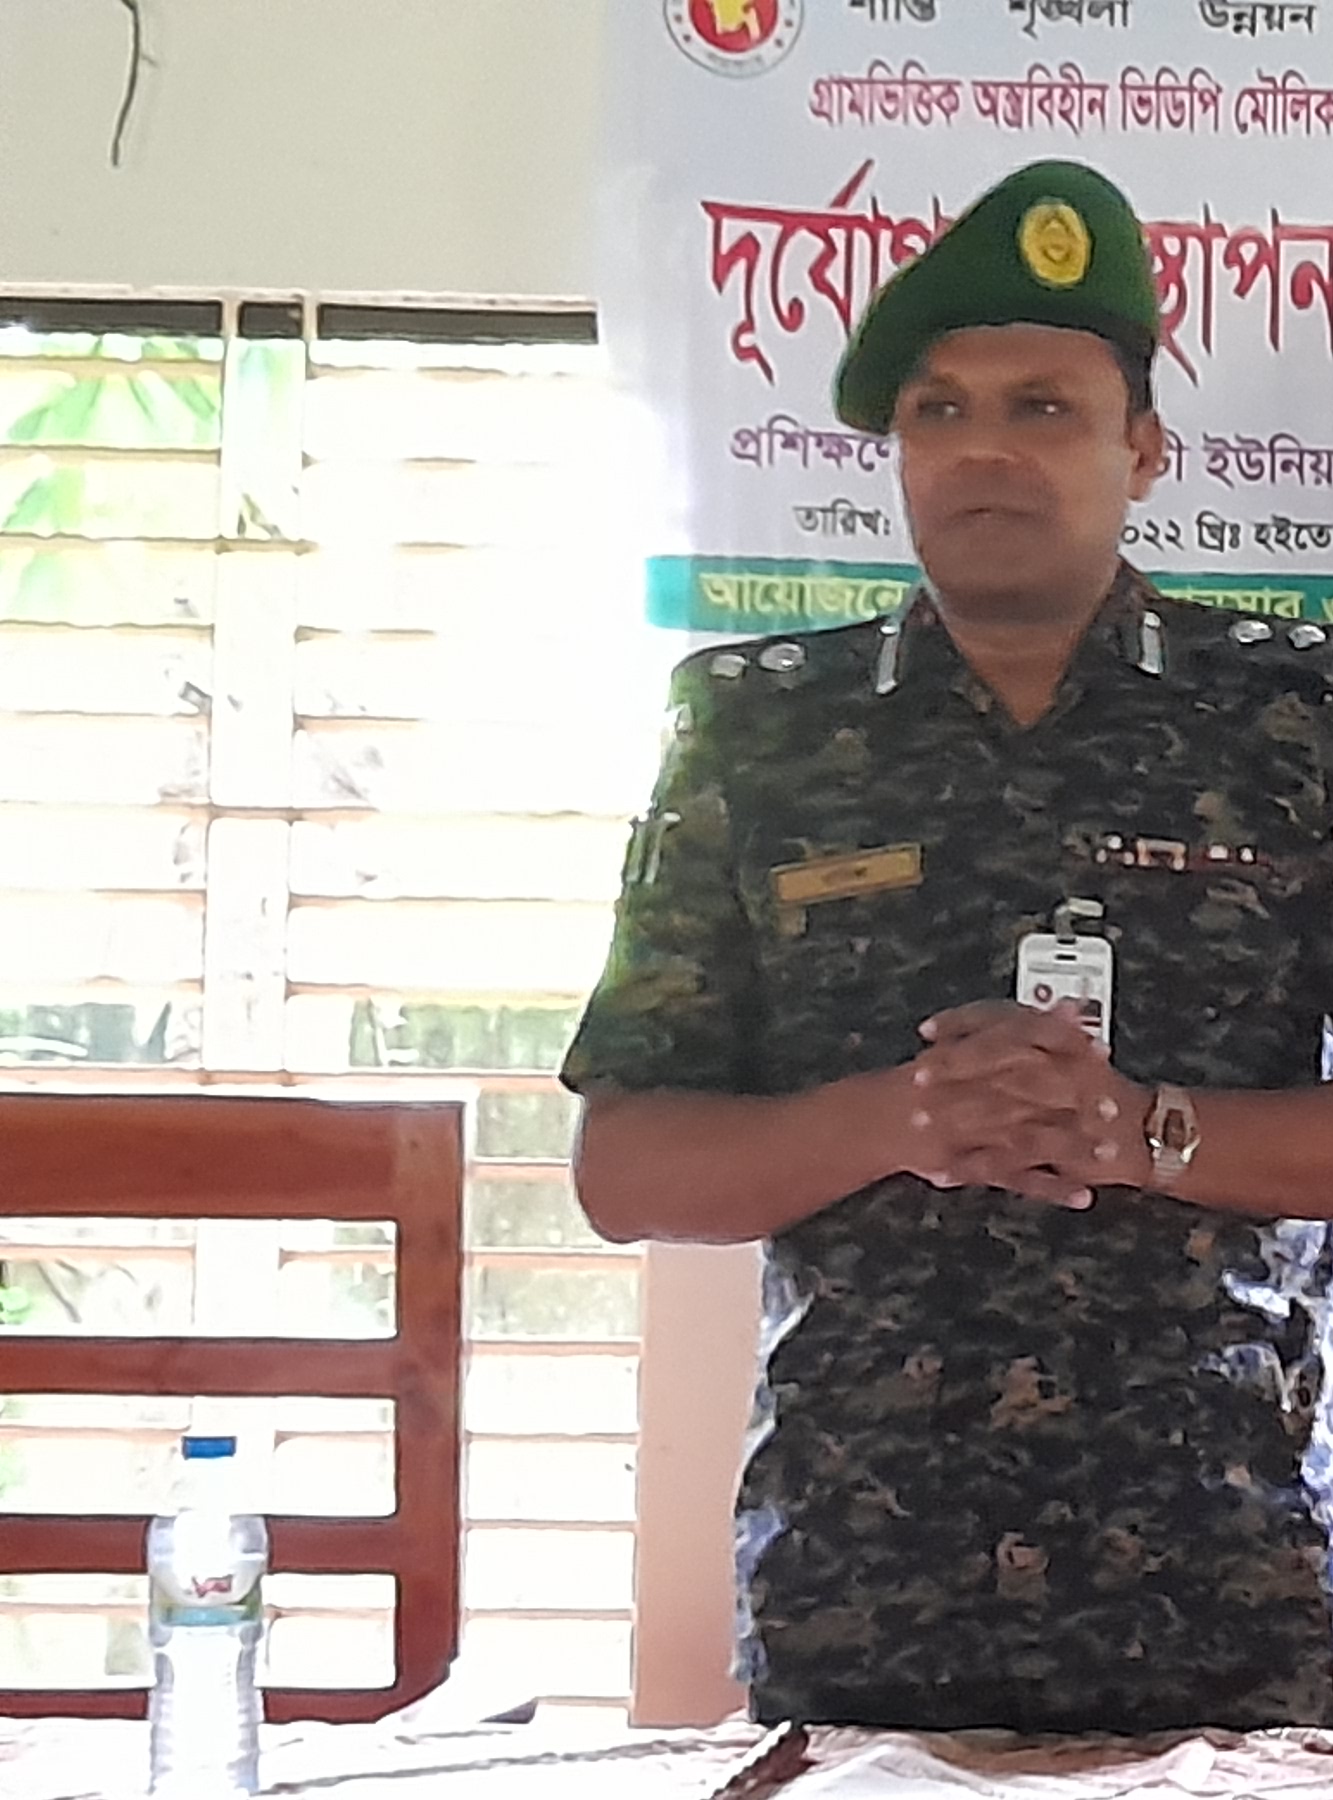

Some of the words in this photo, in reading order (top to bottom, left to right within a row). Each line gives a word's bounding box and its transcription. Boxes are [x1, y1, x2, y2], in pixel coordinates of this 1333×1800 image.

[810, 60, 962, 127] গ্রামভিত্তিক
[1120, 66, 1222, 134] ভিডিপি
[1121, 519, 1184, 551] ০২২
